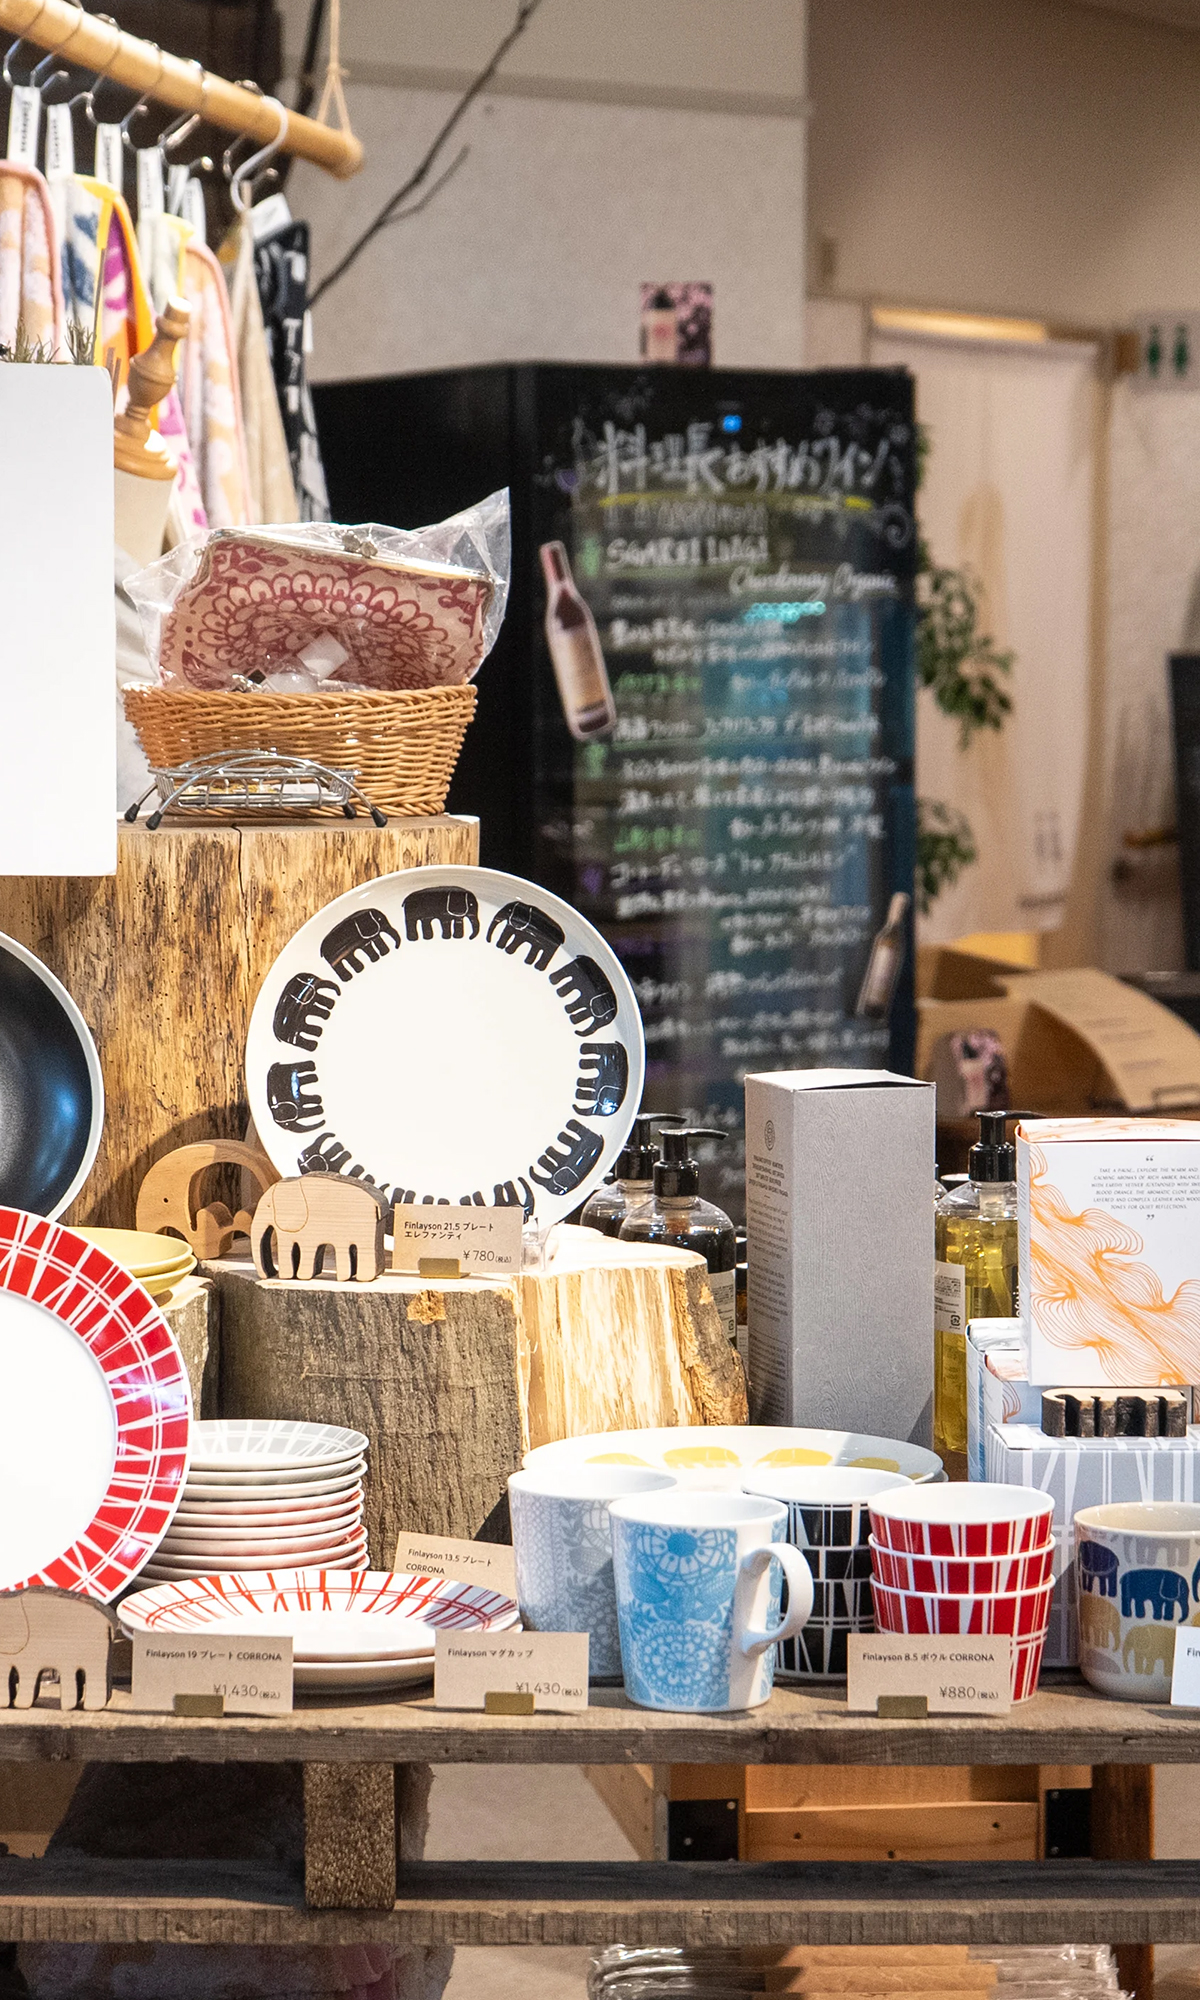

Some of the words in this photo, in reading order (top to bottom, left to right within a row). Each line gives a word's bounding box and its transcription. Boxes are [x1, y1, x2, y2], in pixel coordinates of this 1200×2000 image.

[404, 1221, 442, 1234] Finlayson
[443, 1222, 461, 1231] 21.5
[463, 1222, 494, 1232] プレート
[404, 1231, 462, 1240] エレファンティ
[408, 1548, 443, 1561] Finlayson
[444, 1553, 460, 1562] 13.5
[462, 1555, 492, 1567] プレート
[405, 1562, 446, 1575] CORRONA
[146, 1649, 186, 1660] Finlayson
[187, 1650, 197, 1659] 19
[200, 1650, 234, 1660] プレート
[236, 1651, 282, 1661] CORRONA
[447, 1648, 487, 1659] Finlayson
[490, 1648, 534, 1658] マグカップ
[862, 1652, 903, 1663] Finlayson
[904, 1652, 918, 1661] 8.5
[920, 1652, 947, 1662] ボウル
[949, 1652, 995, 1662] CORRONA
